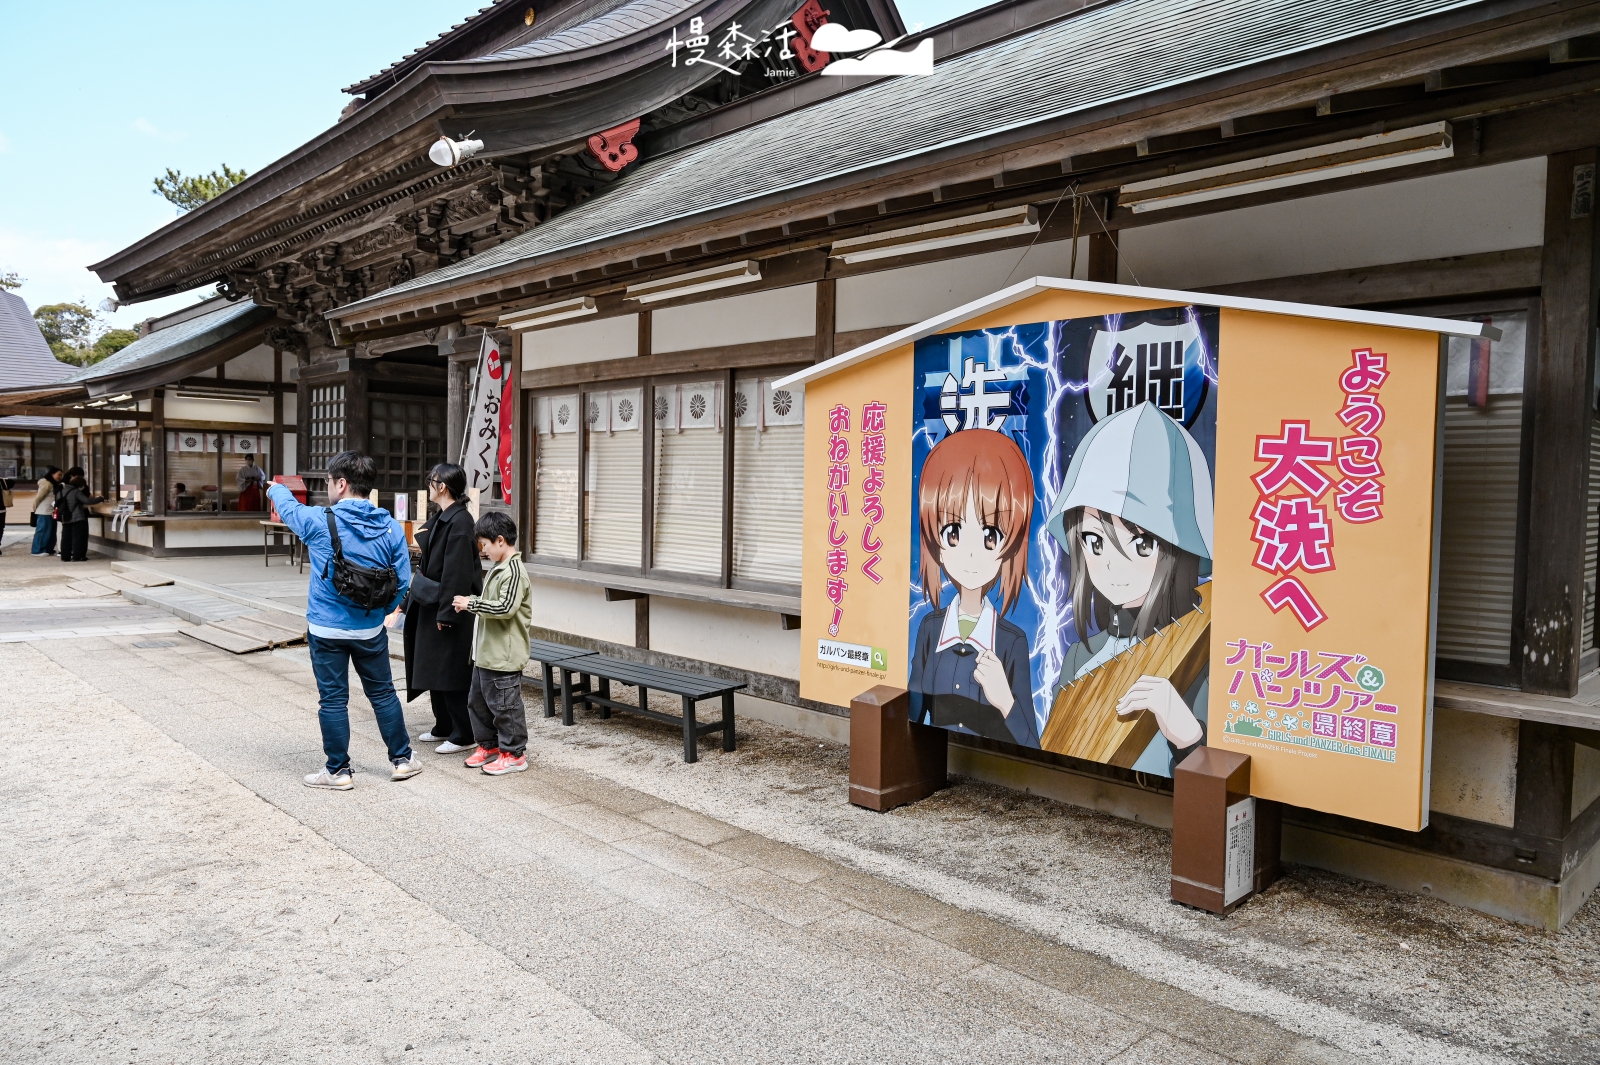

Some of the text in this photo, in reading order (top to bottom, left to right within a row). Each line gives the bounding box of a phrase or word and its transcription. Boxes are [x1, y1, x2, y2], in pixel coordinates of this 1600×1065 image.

[940, 356, 1011, 433] 洗
[473, 388, 500, 494] おみくじ
[1336, 348, 1389, 523] ようこそ
[861, 401, 887, 584] 応援よろしく
[1250, 420, 1336, 632] 大洗へ
[1226, 639, 1367, 683] ガールズ
[1228, 670, 1397, 714] パンツァー
[1258, 742, 1280, 751] PANZER
[1268, 729, 1396, 762] GIRLS und PANZER das FINALE
[1313, 713, 1395, 746] 最終章
